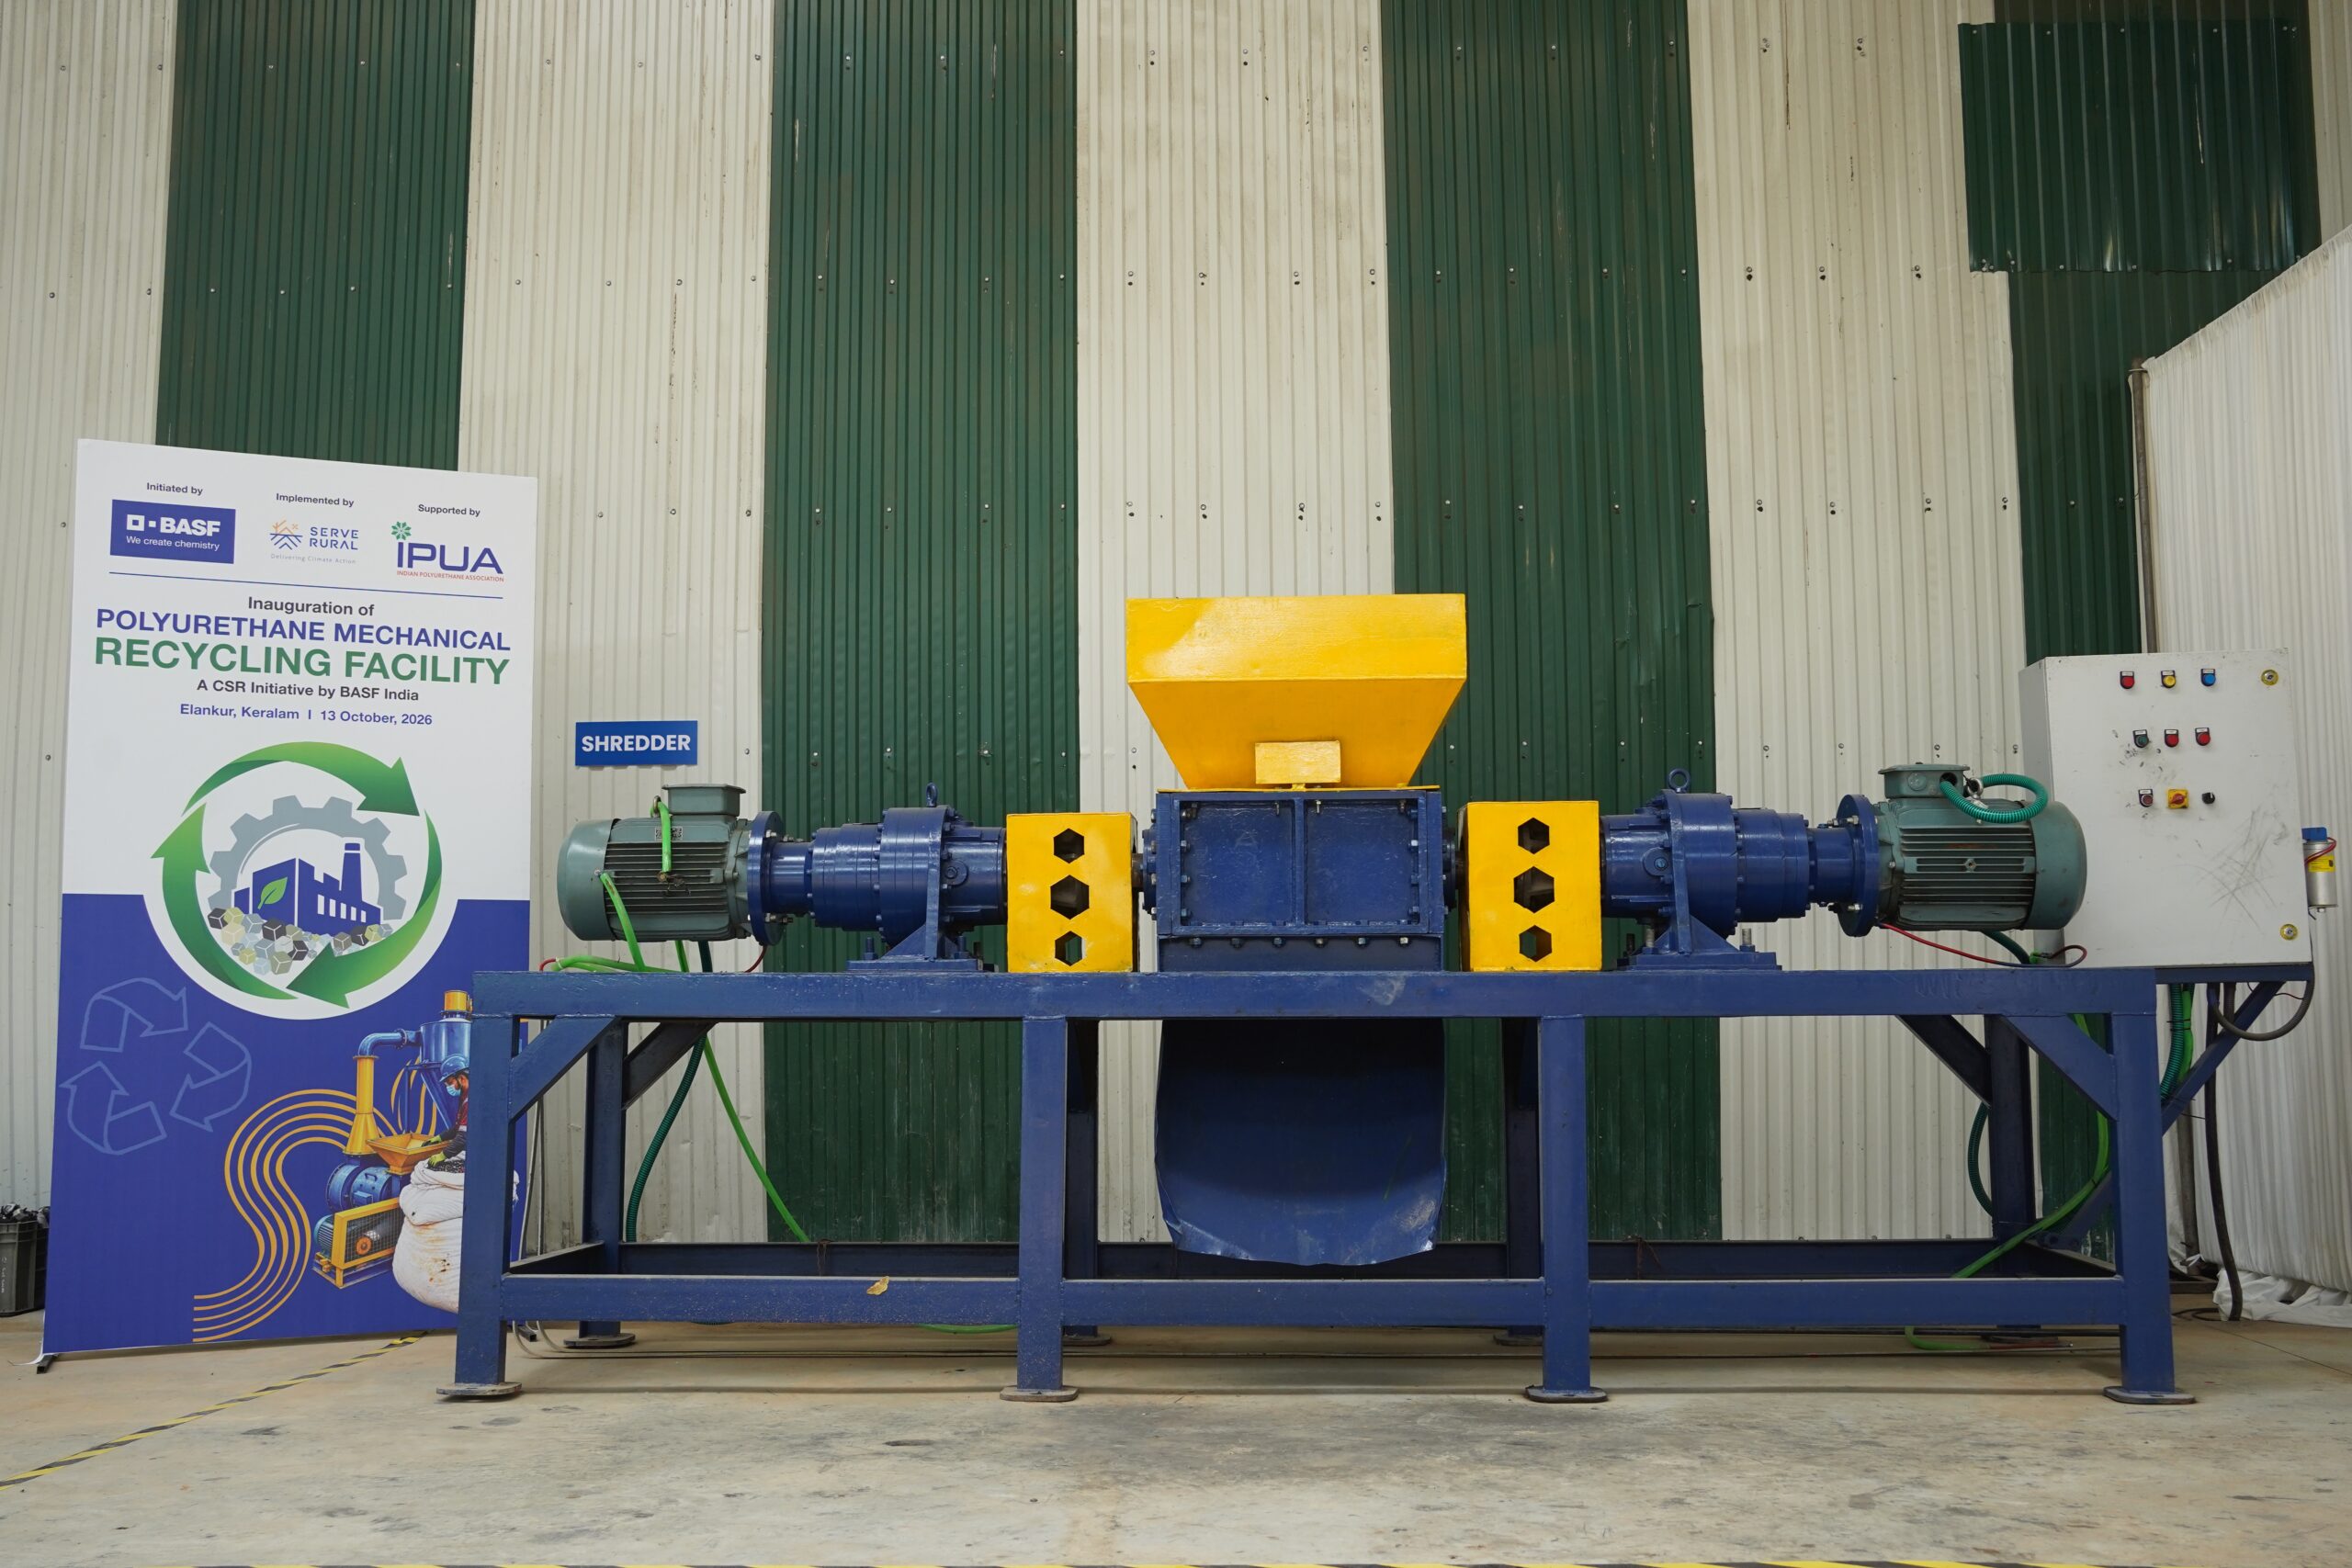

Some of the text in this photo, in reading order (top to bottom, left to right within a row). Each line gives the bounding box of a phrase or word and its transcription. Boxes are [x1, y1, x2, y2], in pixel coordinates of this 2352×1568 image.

[146, 482, 203, 496] Initiated by
[276, 492, 355, 508] Implemented by
[418, 503, 481, 517] Supported by
[160, 516, 220, 536] BASF
[310, 526, 359, 538] SERVE
[126, 536, 220, 551] We create chemistry
[309, 537, 358, 550] RURAL
[270, 553, 306, 562] Delivering
[419, 571, 465, 580] POLYURETHANE
[248, 596, 376, 616] Inauguration of
[96, 608, 512, 651] POLYURETHANE MECHANICAL
[95, 637, 511, 685] RECYCLING FACILITY
[197, 679, 419, 701] A CSR Initiative by BASF India
[180, 704, 237, 718] Elankur,
[242, 705, 300, 719] Keralam
[321, 710, 336, 722] 13
[340, 711, 398, 725] October,
[401, 714, 433, 726] 2026
[582, 734, 691, 752] SHREDDER
